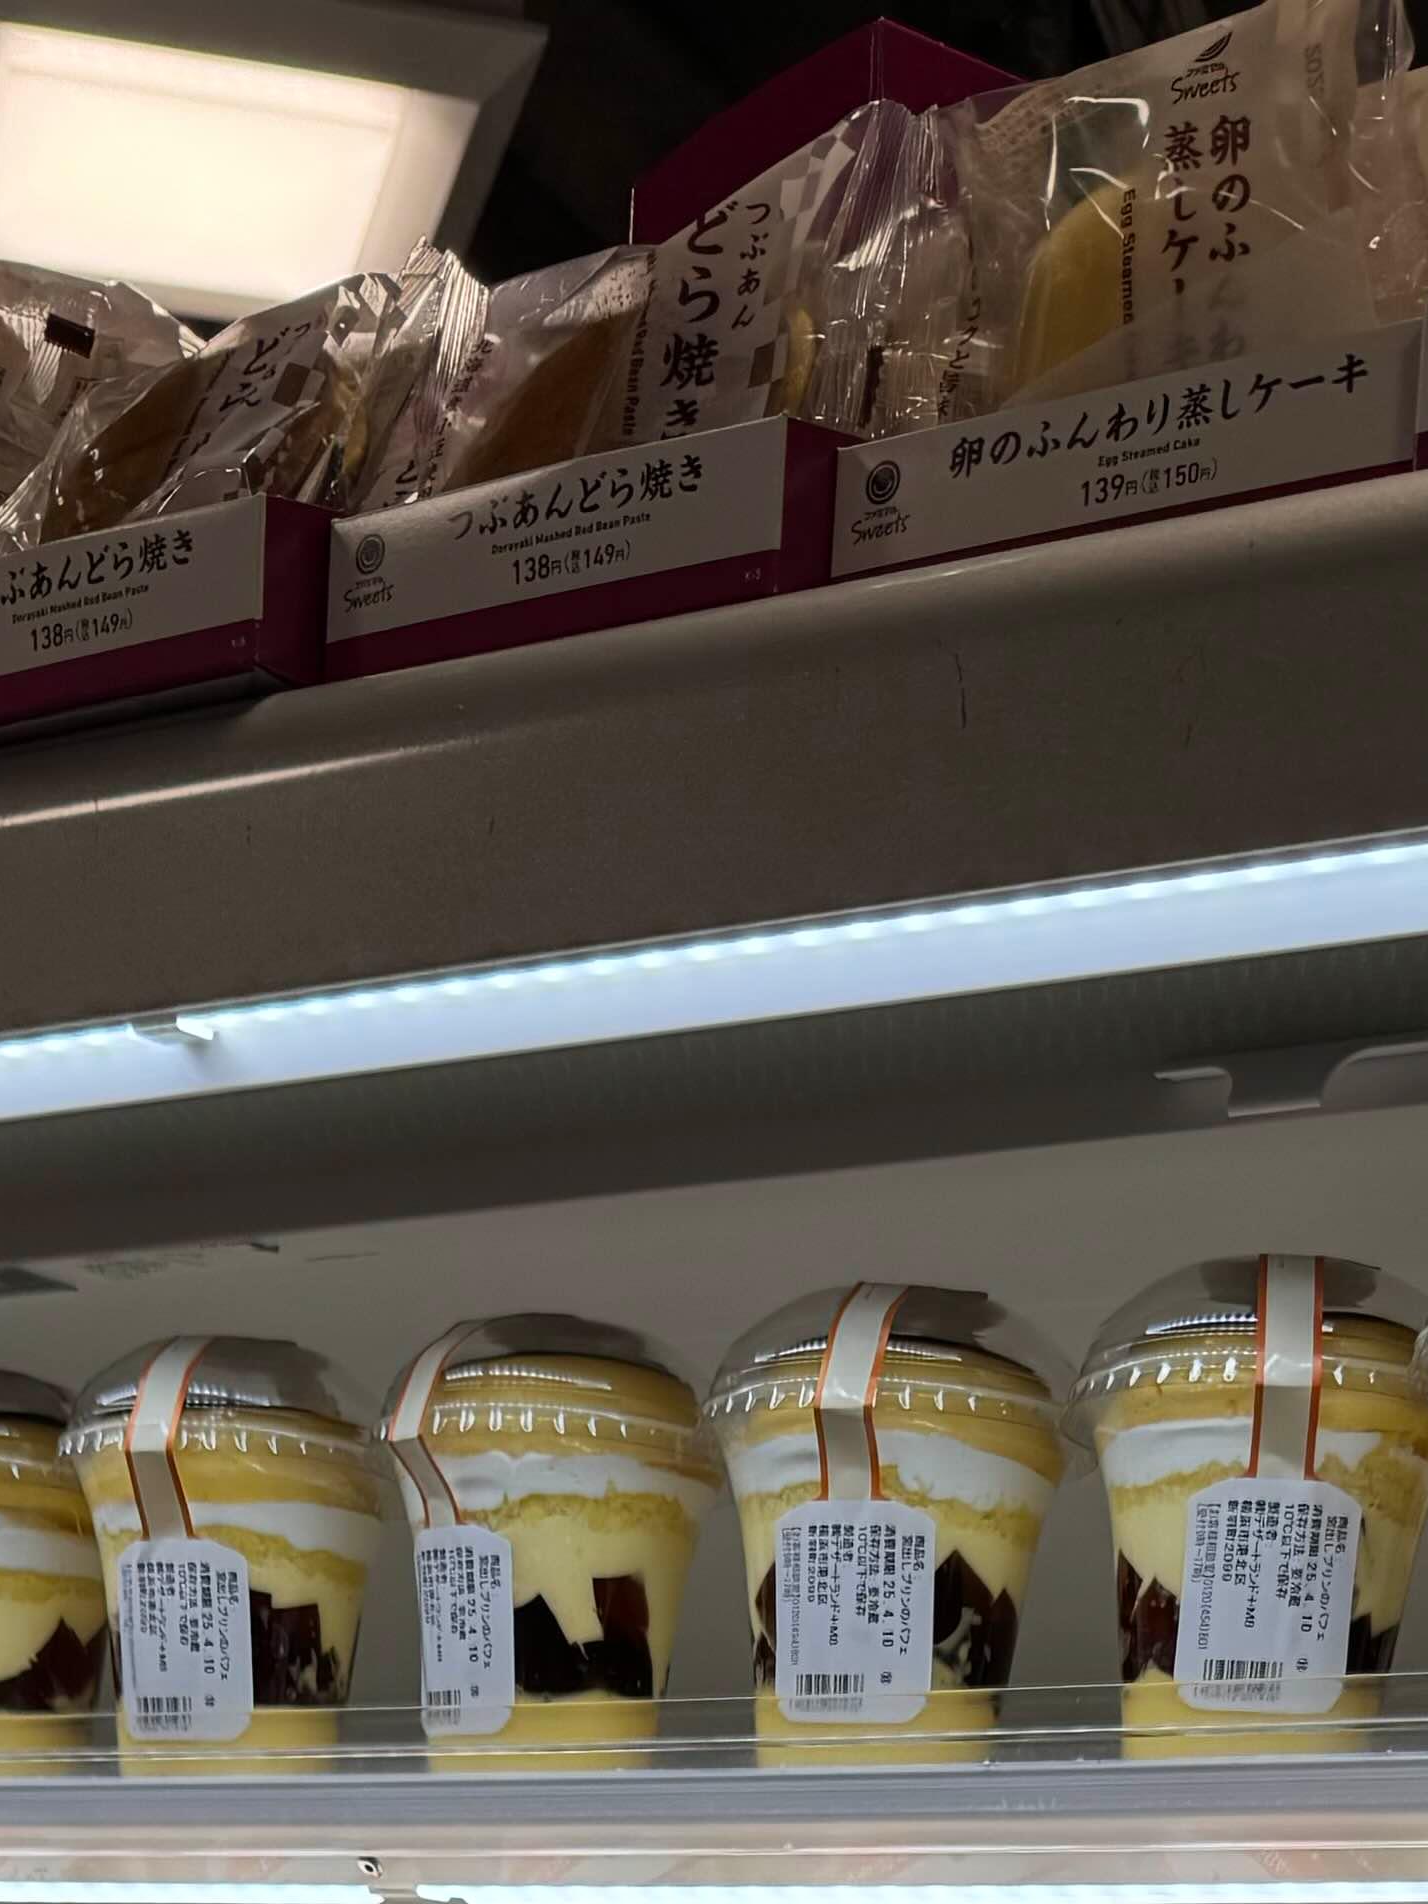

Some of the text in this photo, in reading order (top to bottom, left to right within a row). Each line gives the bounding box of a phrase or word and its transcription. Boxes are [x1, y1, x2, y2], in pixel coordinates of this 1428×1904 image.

[1171, 69, 1242, 105] Sweets
[1121, 188, 1137, 230] Egg
[731, 201, 772, 330] つぶあん
[660, 199, 739, 427] どら焼き
[949, 351, 1369, 480] 卵のふんわり蒸しケーキ
[1098, 453, 1120, 469] Egg
[1122, 442, 1171, 464] Steamed
[448, 455, 704, 541] つぶあんどら焼き
[575, 523, 593, 537] Red
[596, 518, 621, 533] Bean
[623, 511, 652, 527] Paste
[851, 513, 910, 546] Sweets
[102, 589, 123, 603] Bean
[125, 584, 150, 597] Paste
[344, 582, 394, 613] Sweets
